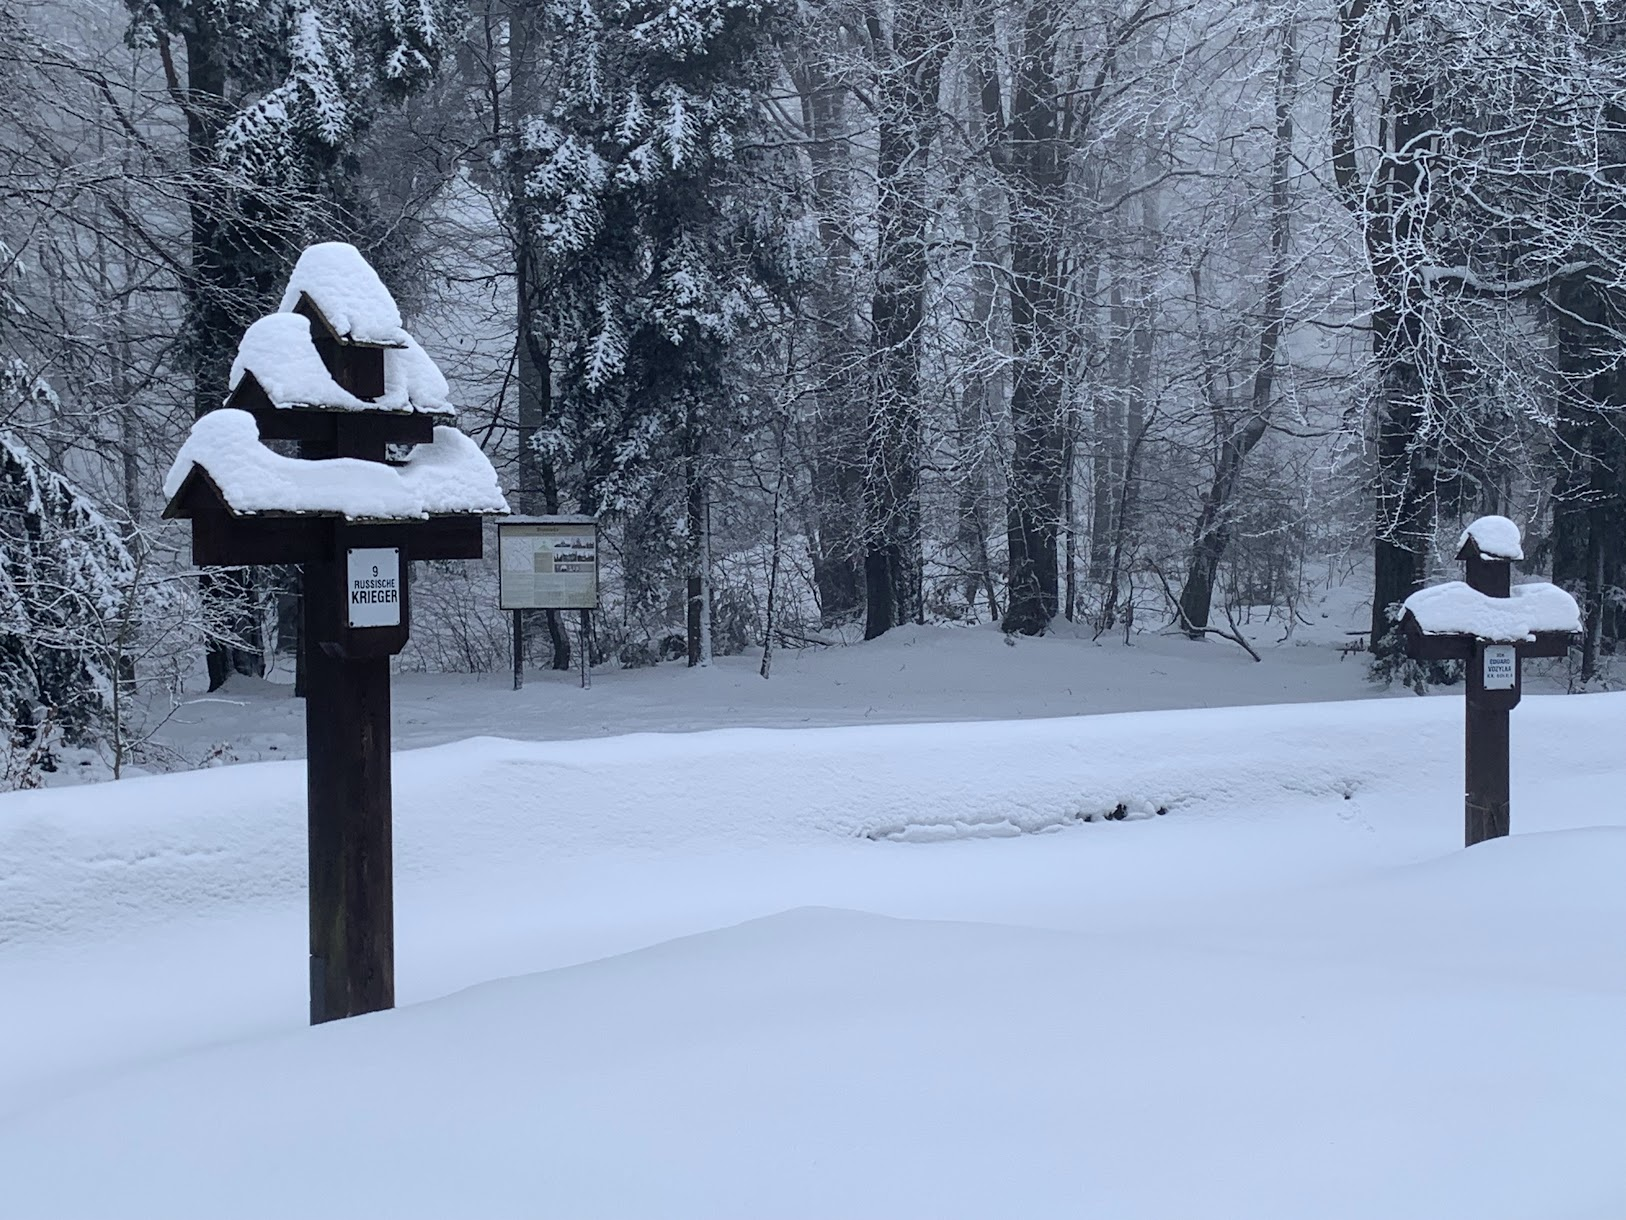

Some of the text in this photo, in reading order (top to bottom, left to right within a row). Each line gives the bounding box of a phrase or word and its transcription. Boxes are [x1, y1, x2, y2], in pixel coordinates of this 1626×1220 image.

[372, 566, 378, 577] 9
[354, 579, 395, 589] RUSSISCHE
[352, 590, 398, 604] KRIEGER
